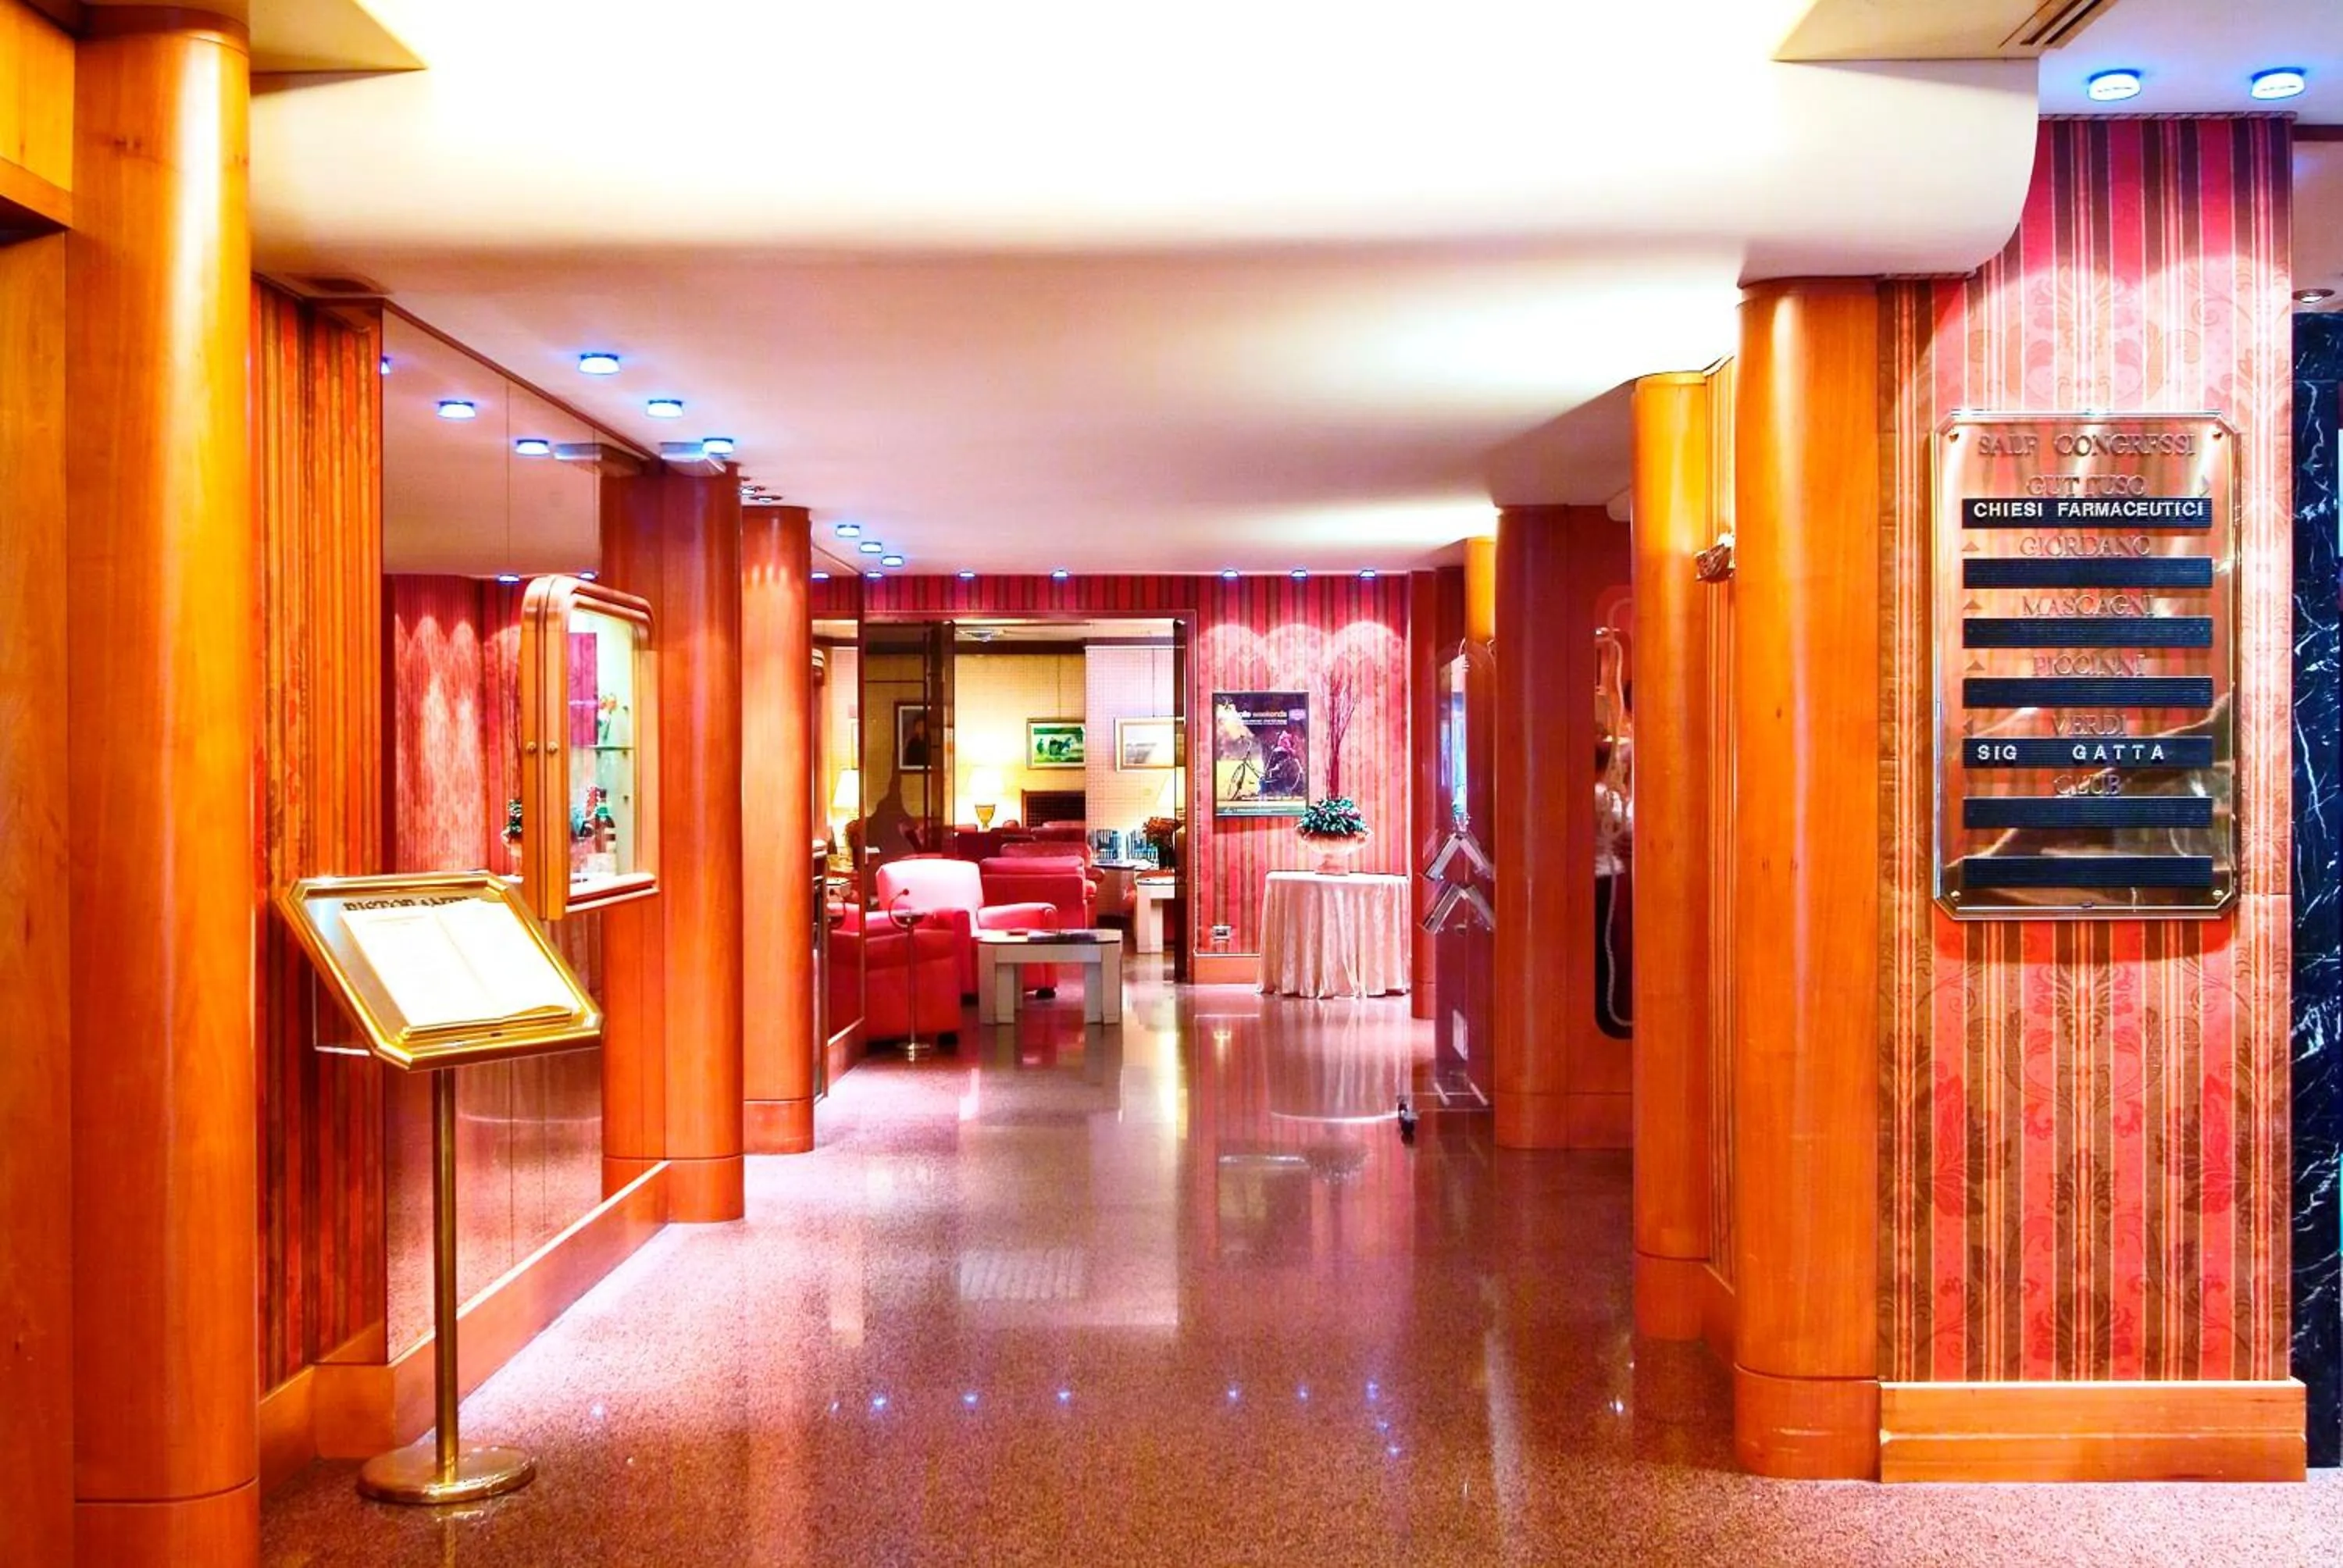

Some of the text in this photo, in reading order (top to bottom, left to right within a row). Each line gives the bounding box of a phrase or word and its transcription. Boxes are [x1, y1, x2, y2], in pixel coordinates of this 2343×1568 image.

[2054, 433, 2196, 457] CONGRESSI
[2025, 474, 2146, 498] GUTTUSO
[1973, 501, 2204, 519] CHIESI FARMACEUTICI
[2020, 536, 2151, 557] GIORDANO
[2021, 593, 2155, 616] MASCAGNI
[2050, 714, 2127, 736] VERDI
[1977, 745, 2165, 761] SIG GATTA
